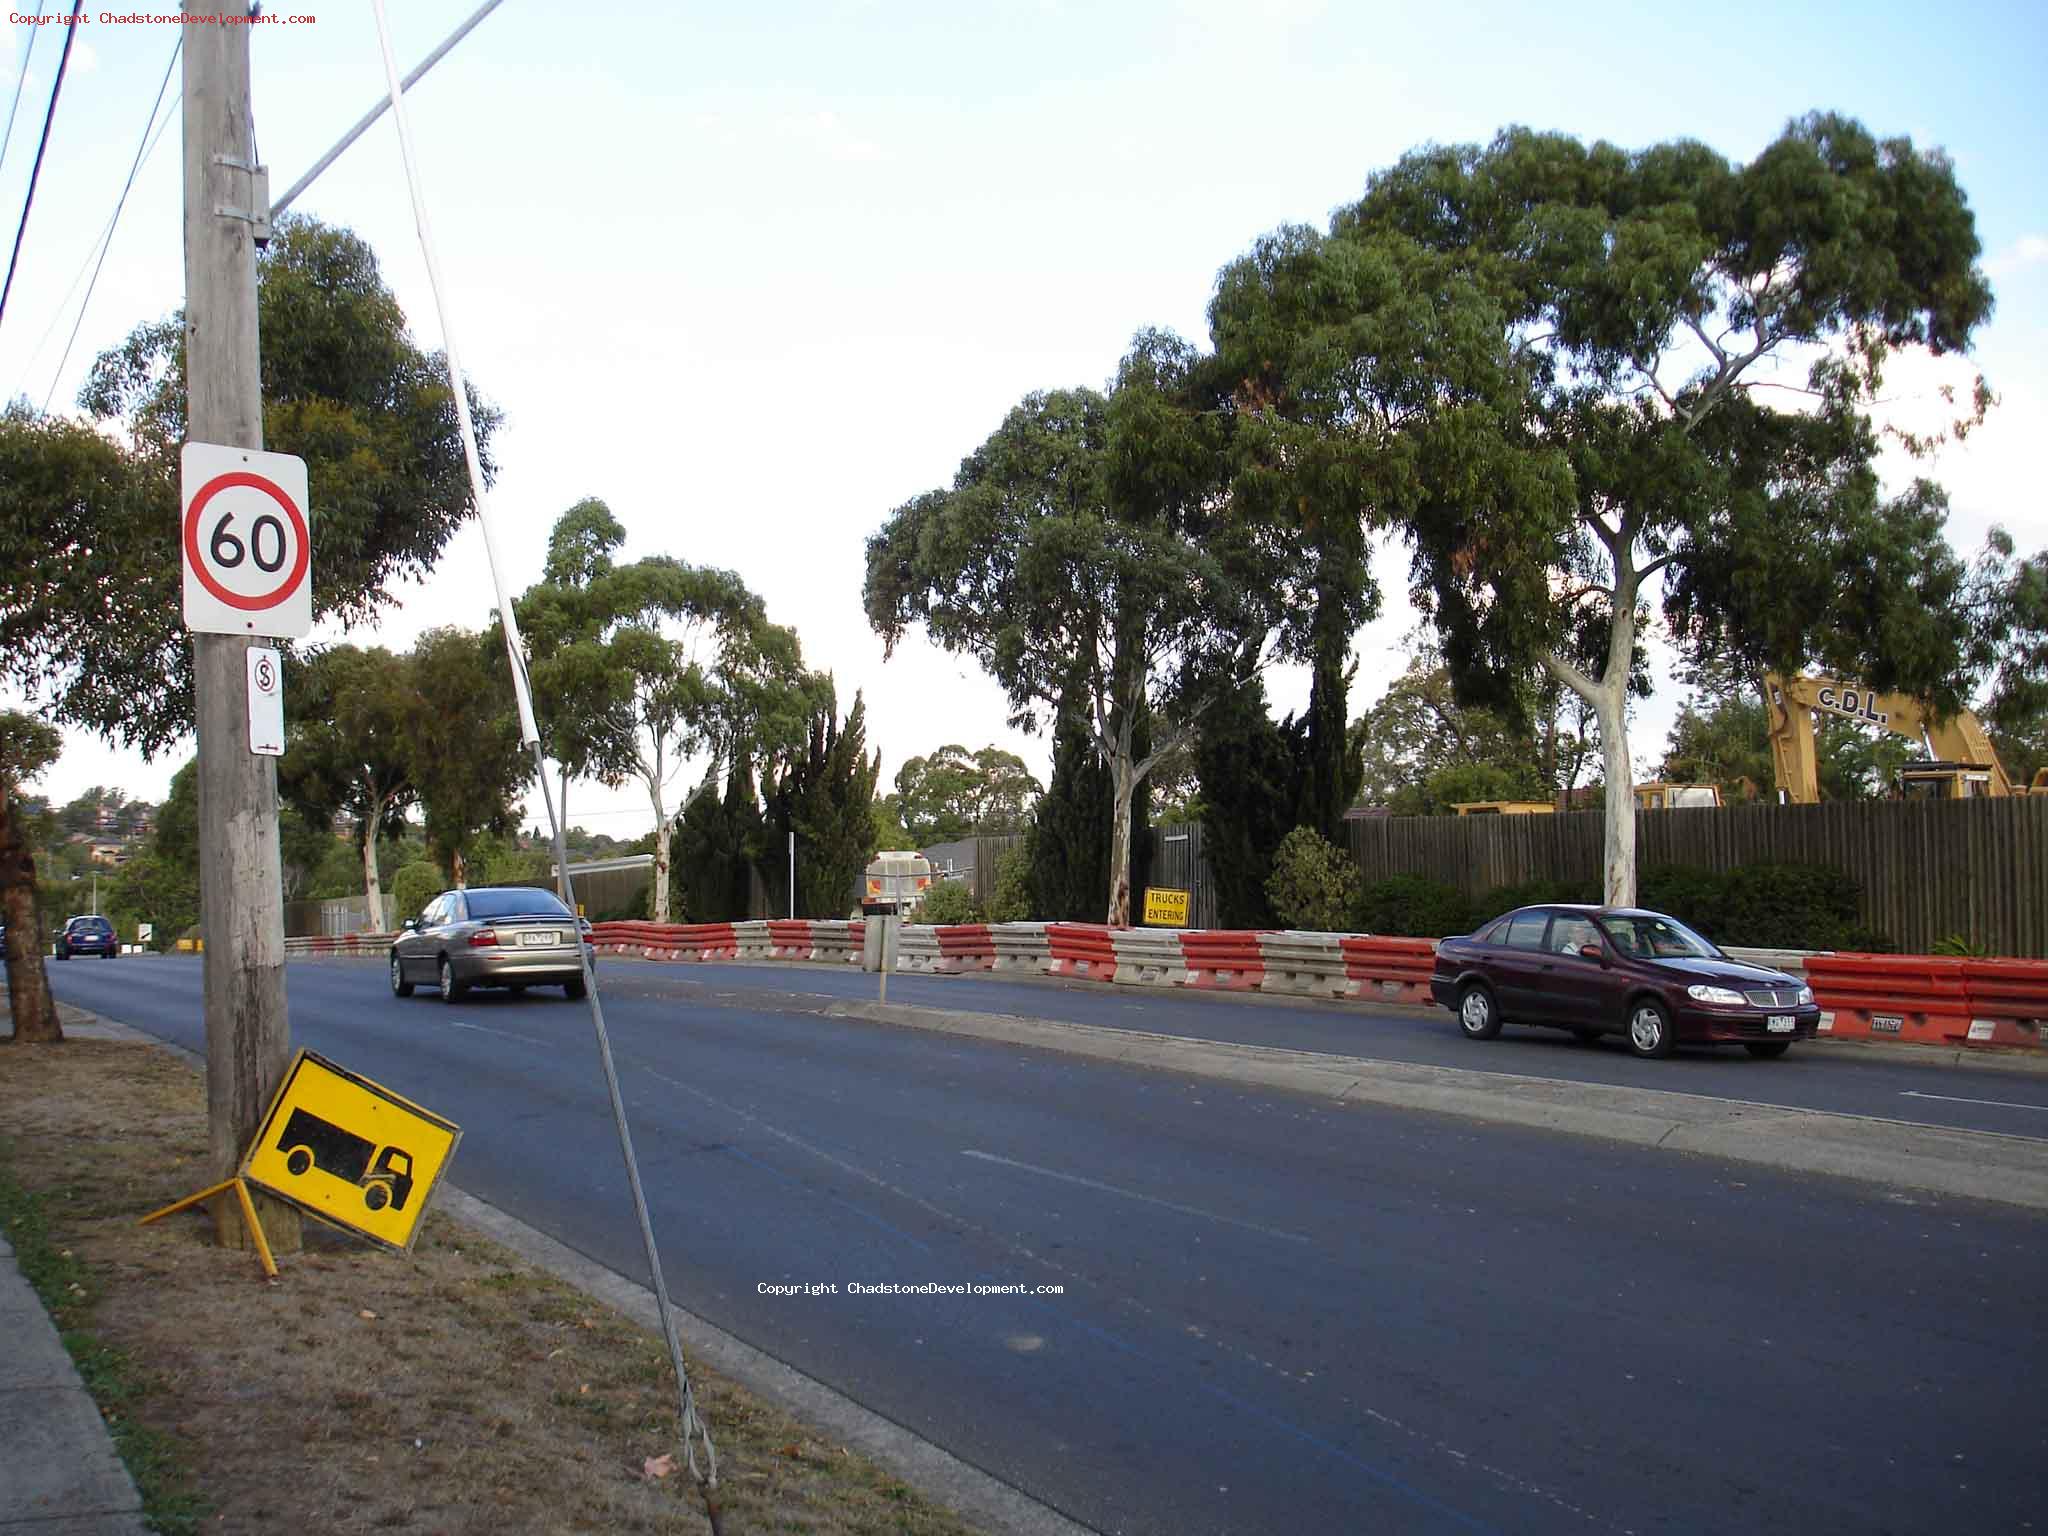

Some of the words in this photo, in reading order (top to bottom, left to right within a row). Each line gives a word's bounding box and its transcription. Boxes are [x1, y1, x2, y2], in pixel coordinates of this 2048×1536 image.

[210, 511, 287, 573] 60
[1818, 687, 1888, 725] C.D.L.
[1151, 892, 1185, 905] TRUCKS
[1148, 908, 1184, 921] ENTERING
